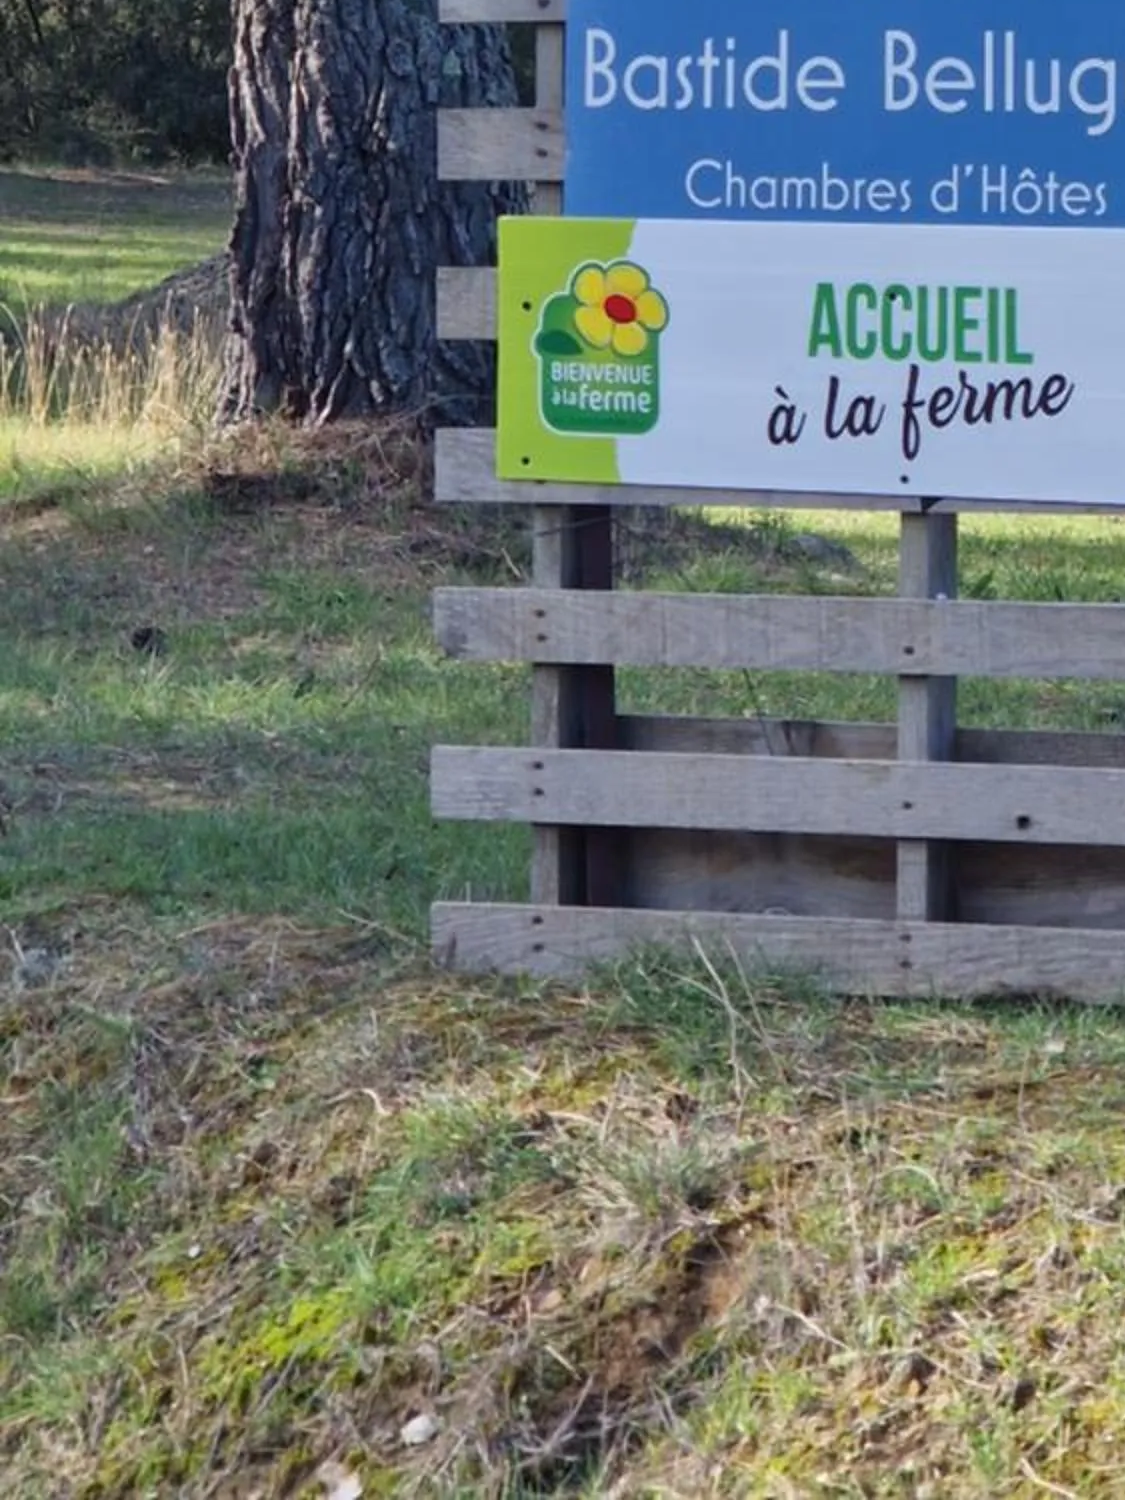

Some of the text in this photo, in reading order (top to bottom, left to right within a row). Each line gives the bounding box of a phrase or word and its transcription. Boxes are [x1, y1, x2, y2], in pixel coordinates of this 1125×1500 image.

[583, 27, 846, 112] Bastide
[684, 158, 1108, 218] Chambres d'Hôtes
[808, 281, 1033, 363] ACCUEIL
[551, 362, 653, 385] BIENVENUE
[579, 384, 652, 413] ferme
[767, 363, 1076, 461] à la ferme
